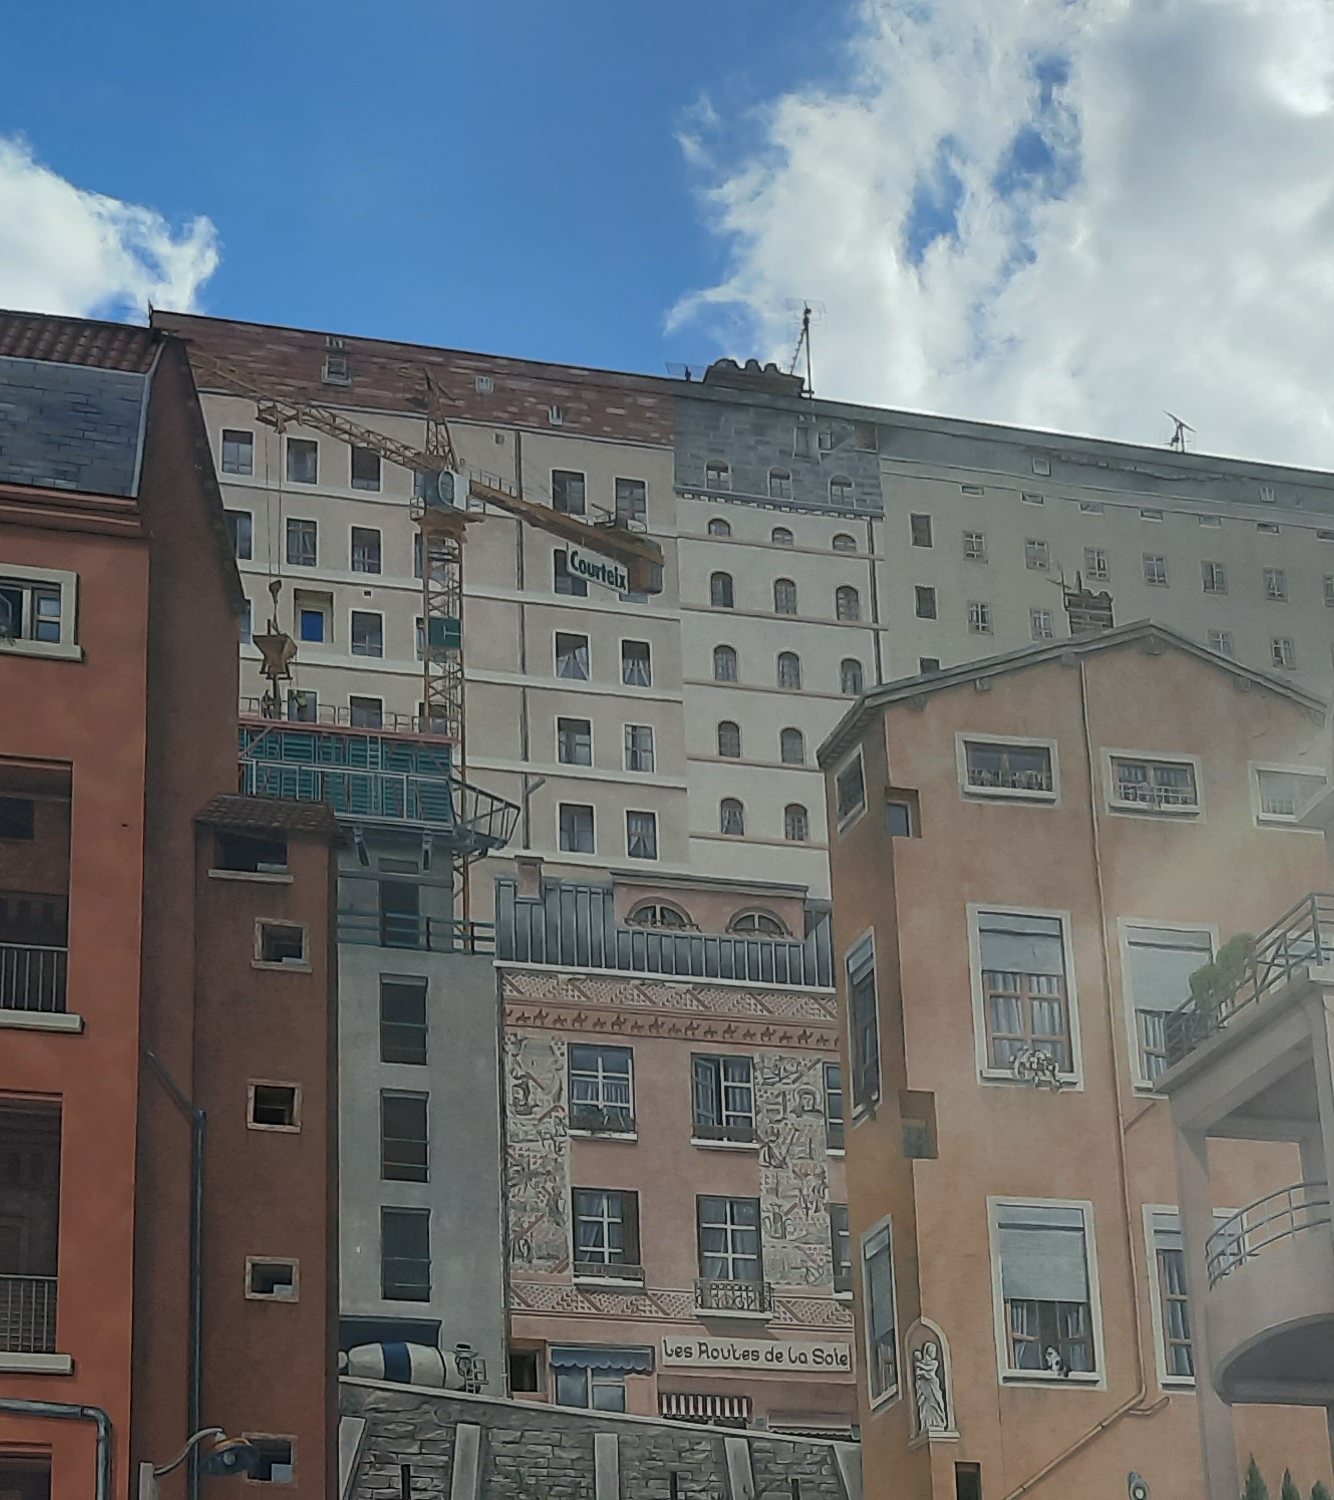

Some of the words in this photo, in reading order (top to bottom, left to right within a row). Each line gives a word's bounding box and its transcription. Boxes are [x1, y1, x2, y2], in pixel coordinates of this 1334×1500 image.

[570, 551, 626, 590] Courteix
[663, 1339, 693, 1358] Les
[697, 1341, 760, 1361] Routes
[764, 1346, 784, 1363] de
[812, 1347, 849, 1366] Soie
